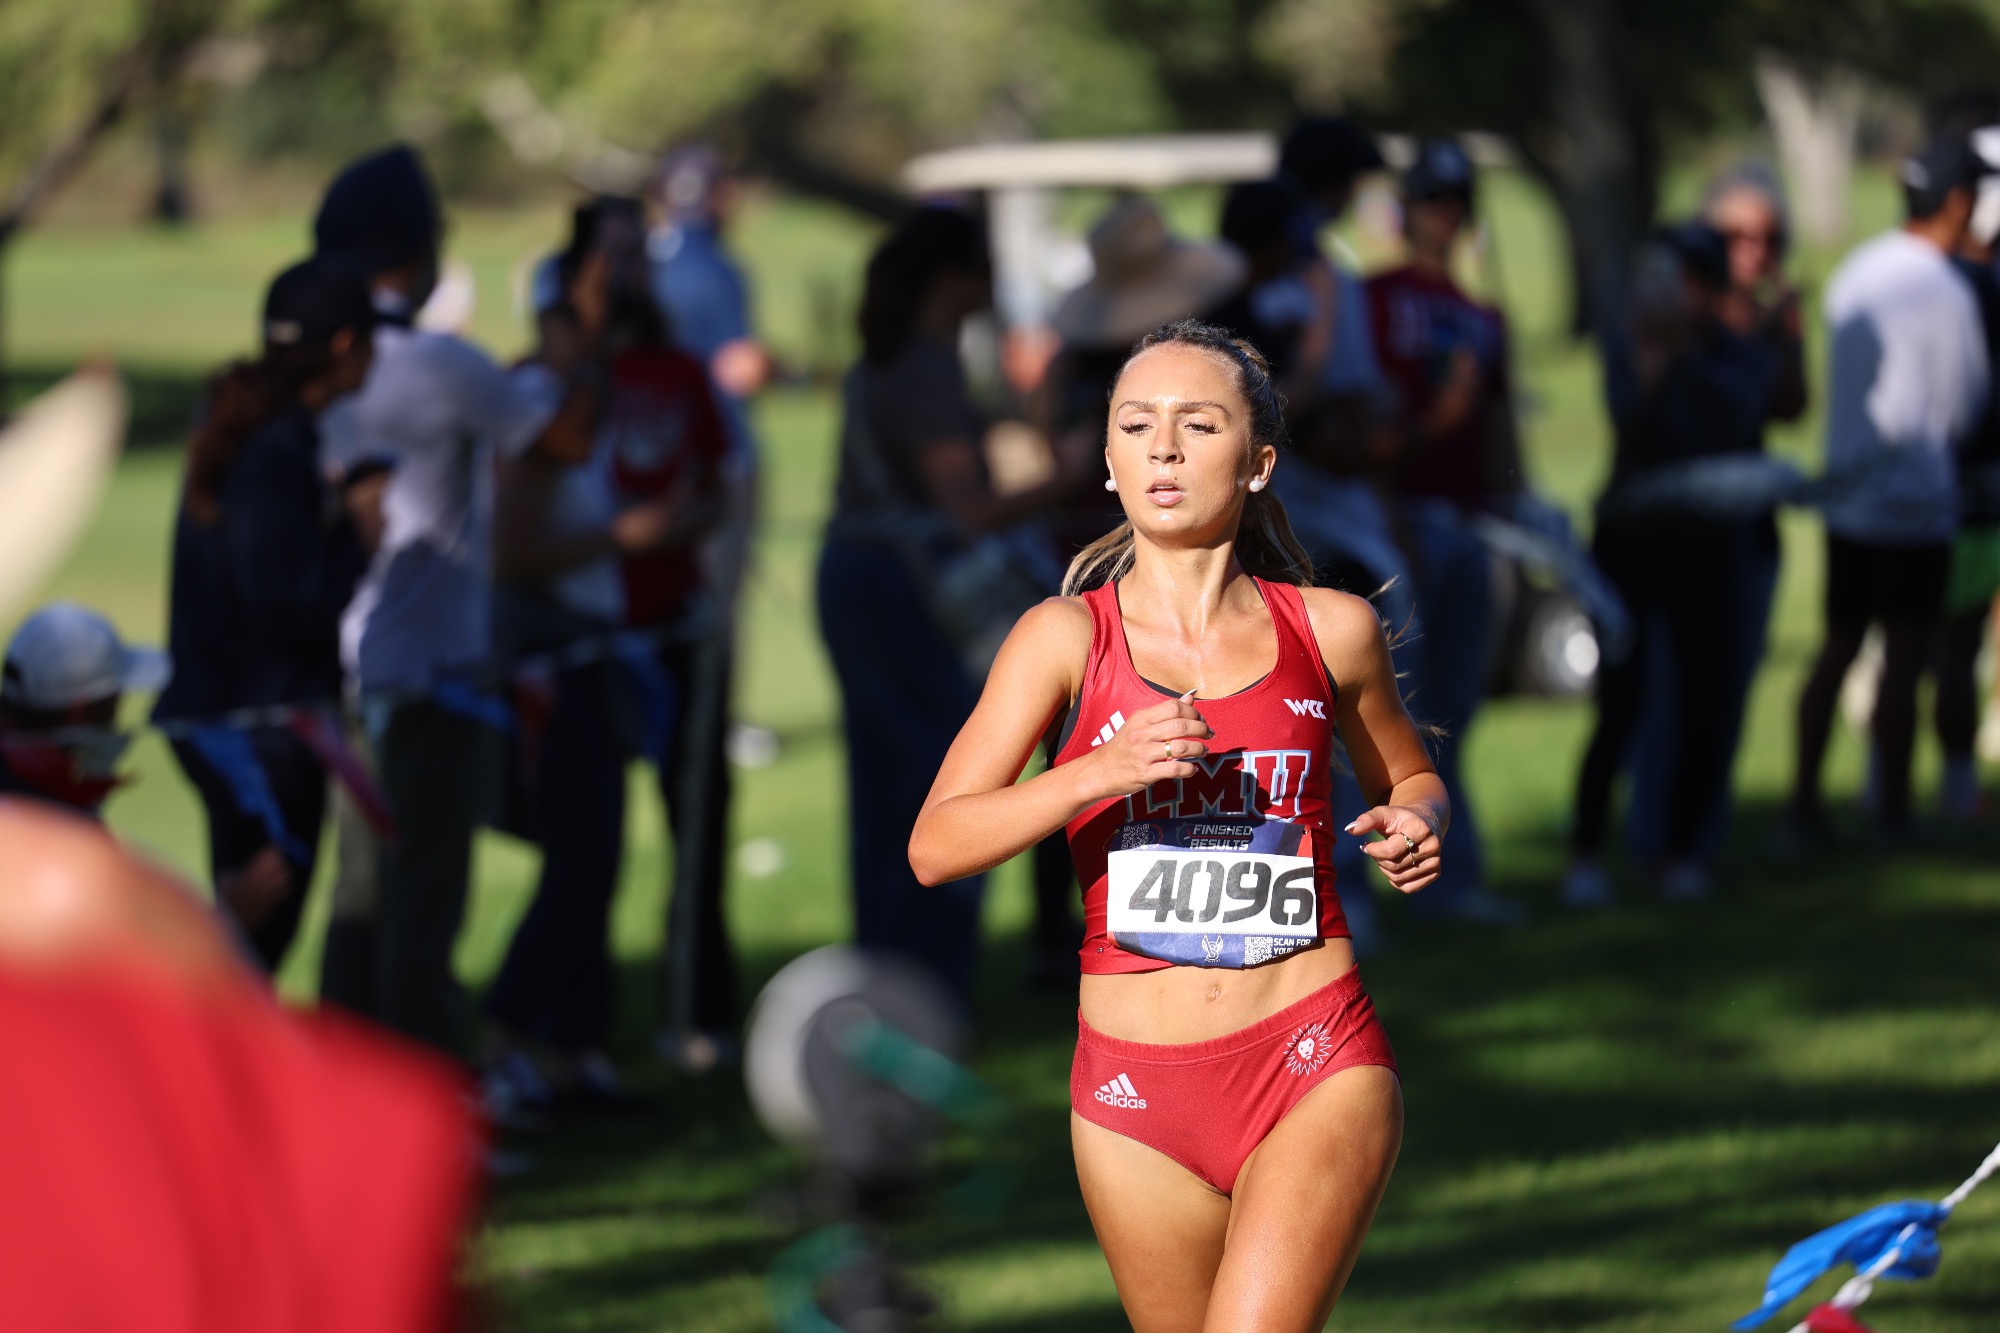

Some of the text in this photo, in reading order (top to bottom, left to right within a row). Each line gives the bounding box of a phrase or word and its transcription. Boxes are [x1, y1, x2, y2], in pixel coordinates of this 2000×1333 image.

[1282, 698, 1327, 720] WCC
[1192, 824, 1253, 836] FINISHED
[1190, 838, 1250, 851] RESULTS
[1128, 859, 1314, 926] 4096
[1273, 937, 1311, 947] SCAN FOR
[1094, 1090, 1147, 1109] adidas
